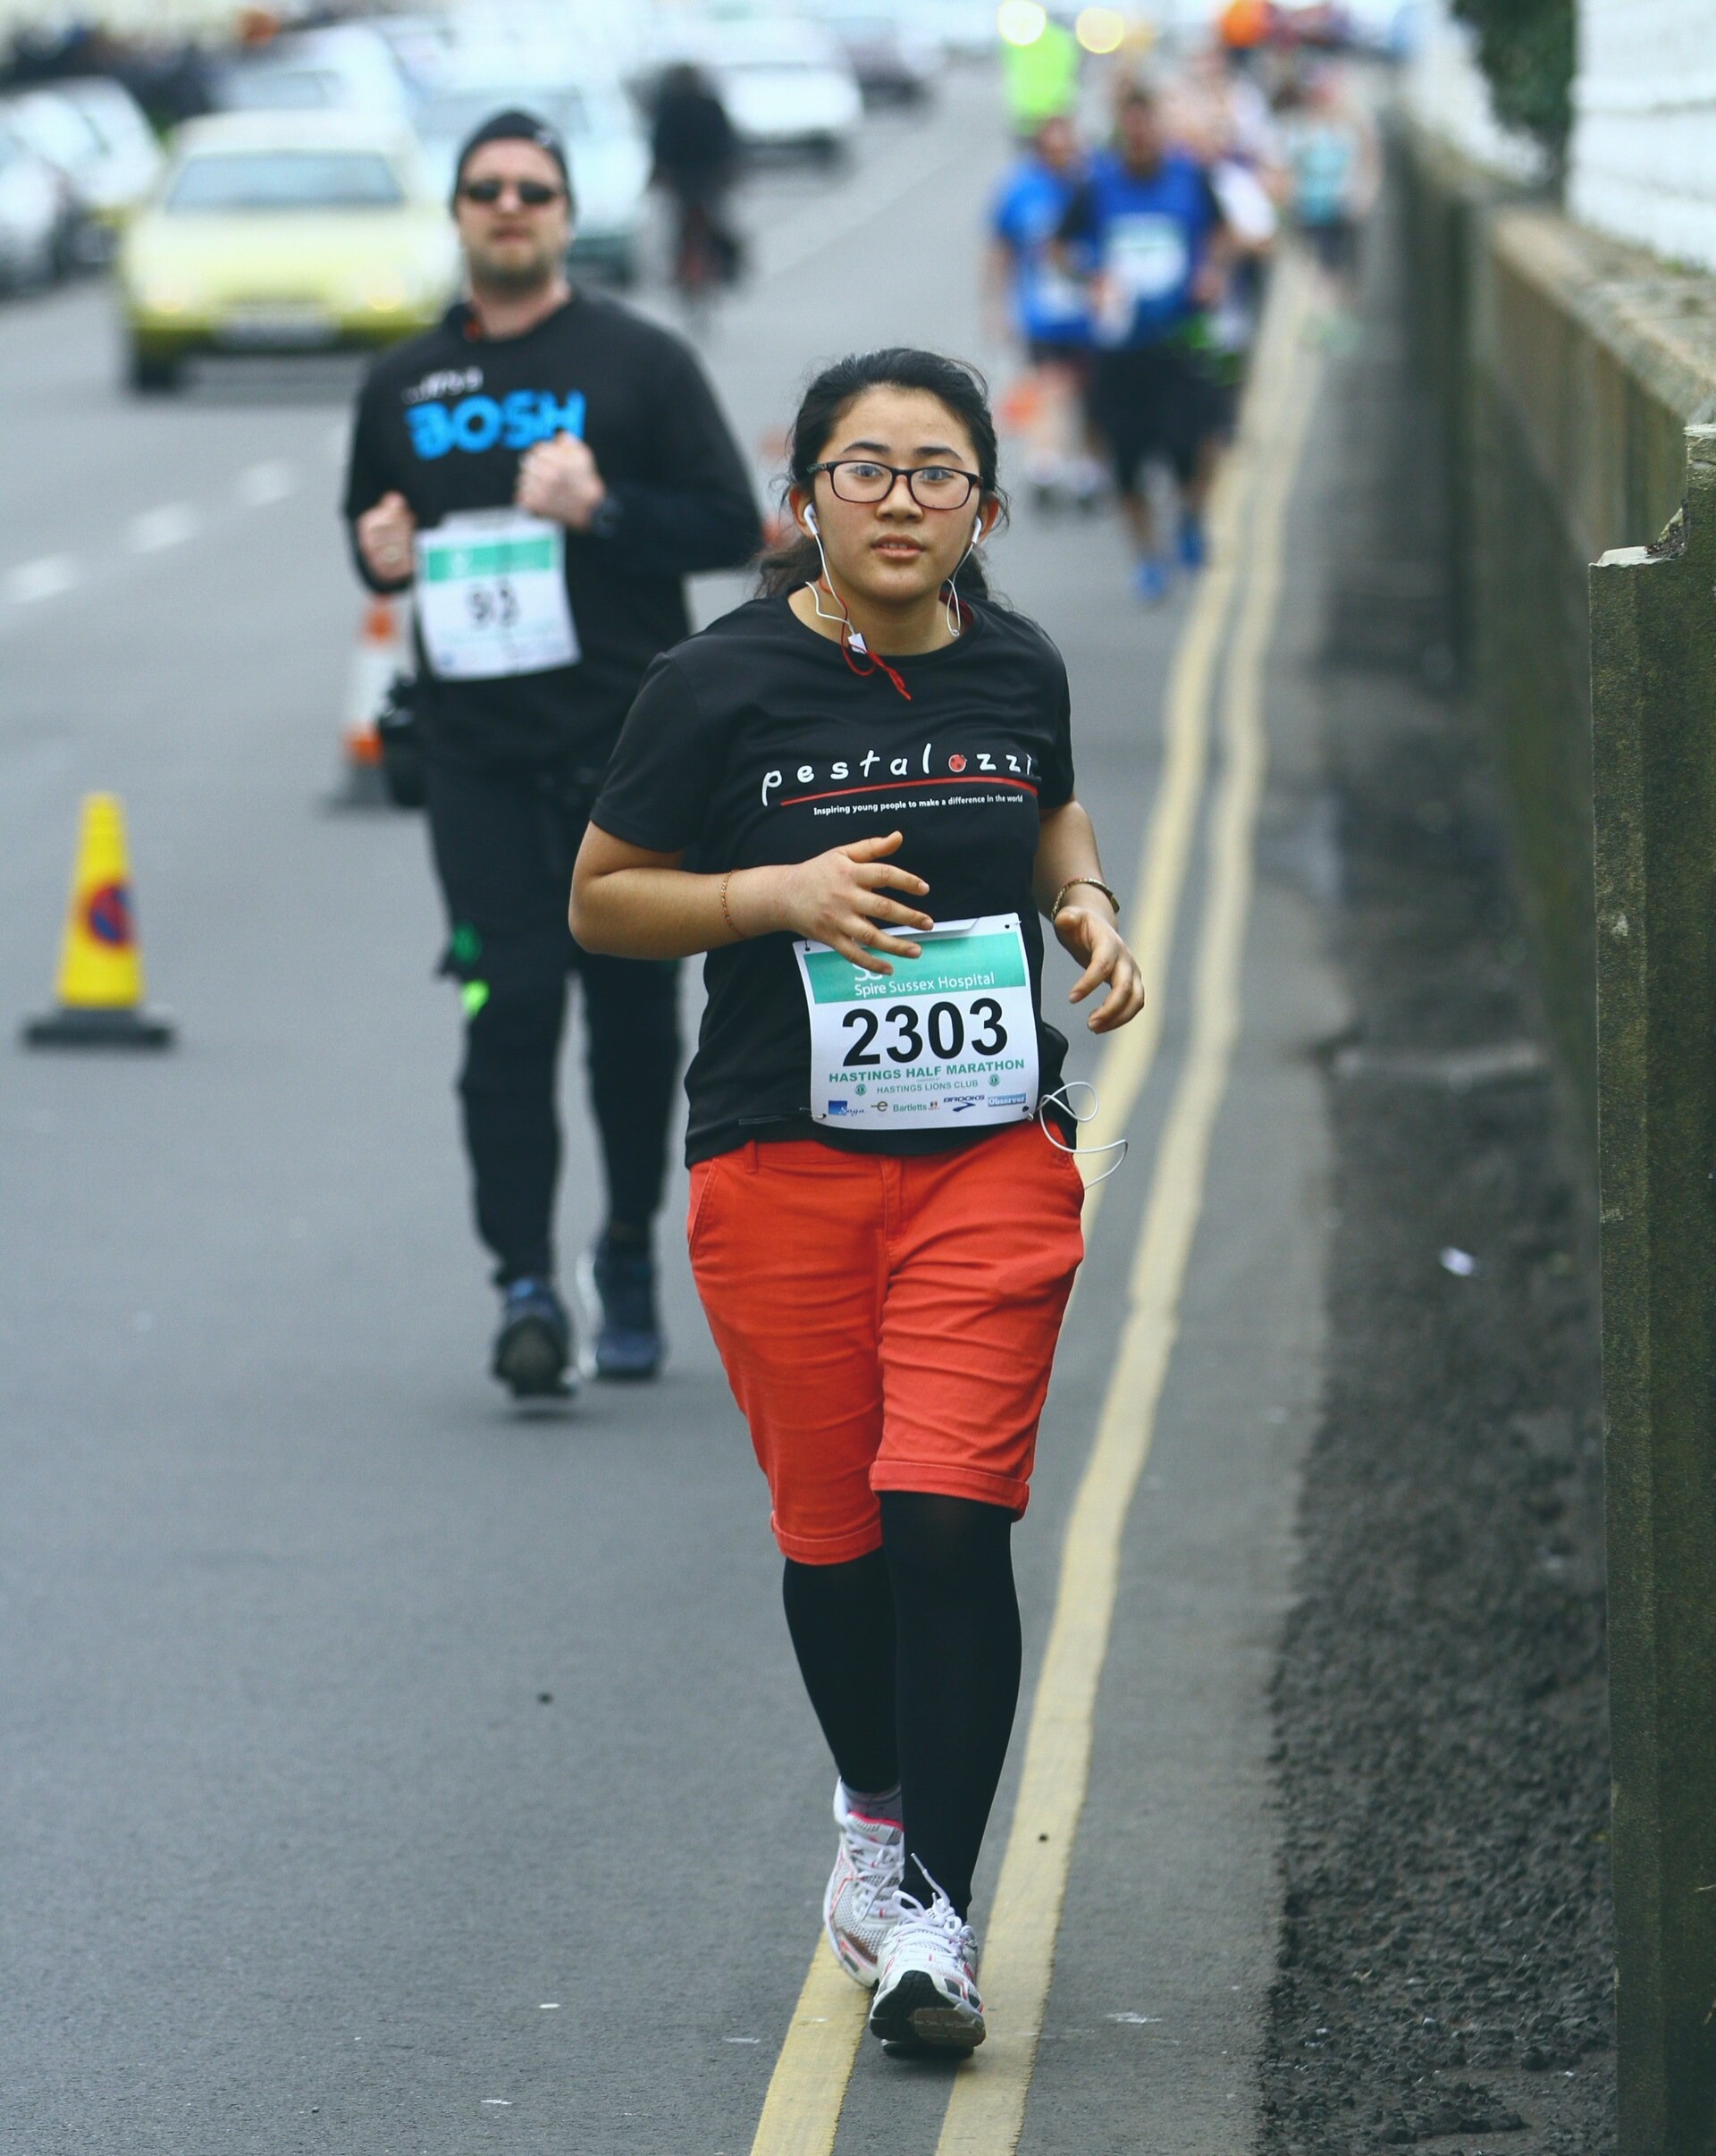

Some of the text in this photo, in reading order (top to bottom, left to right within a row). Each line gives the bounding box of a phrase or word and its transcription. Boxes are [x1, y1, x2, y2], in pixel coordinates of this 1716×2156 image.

[404, 389, 586, 459] BOSH
[813, 805, 850, 816] Inspiring
[852, 804, 878, 813] young
[880, 801, 906, 811] people
[919, 798, 939, 807] make
[947, 796, 985, 805] difference
[987, 795, 994, 803] in
[995, 794, 1005, 803] the
[1006, 795, 1023, 803] world
[854, 971, 995, 998] Spire Sussex Hospital
[842, 998, 1008, 1066] 2303
[829, 1070, 902, 1082] HASTINGS
[905, 1065, 942, 1078] HALF
[946, 1059, 1025, 1074] MARATHON
[877, 1079, 979, 1094] HASTINGS LIONS CLUB
[893, 1103, 927, 1113] Bartletts
[944, 1094, 985, 1103] BROOKS
[988, 1096, 1025, 1106] Observer
